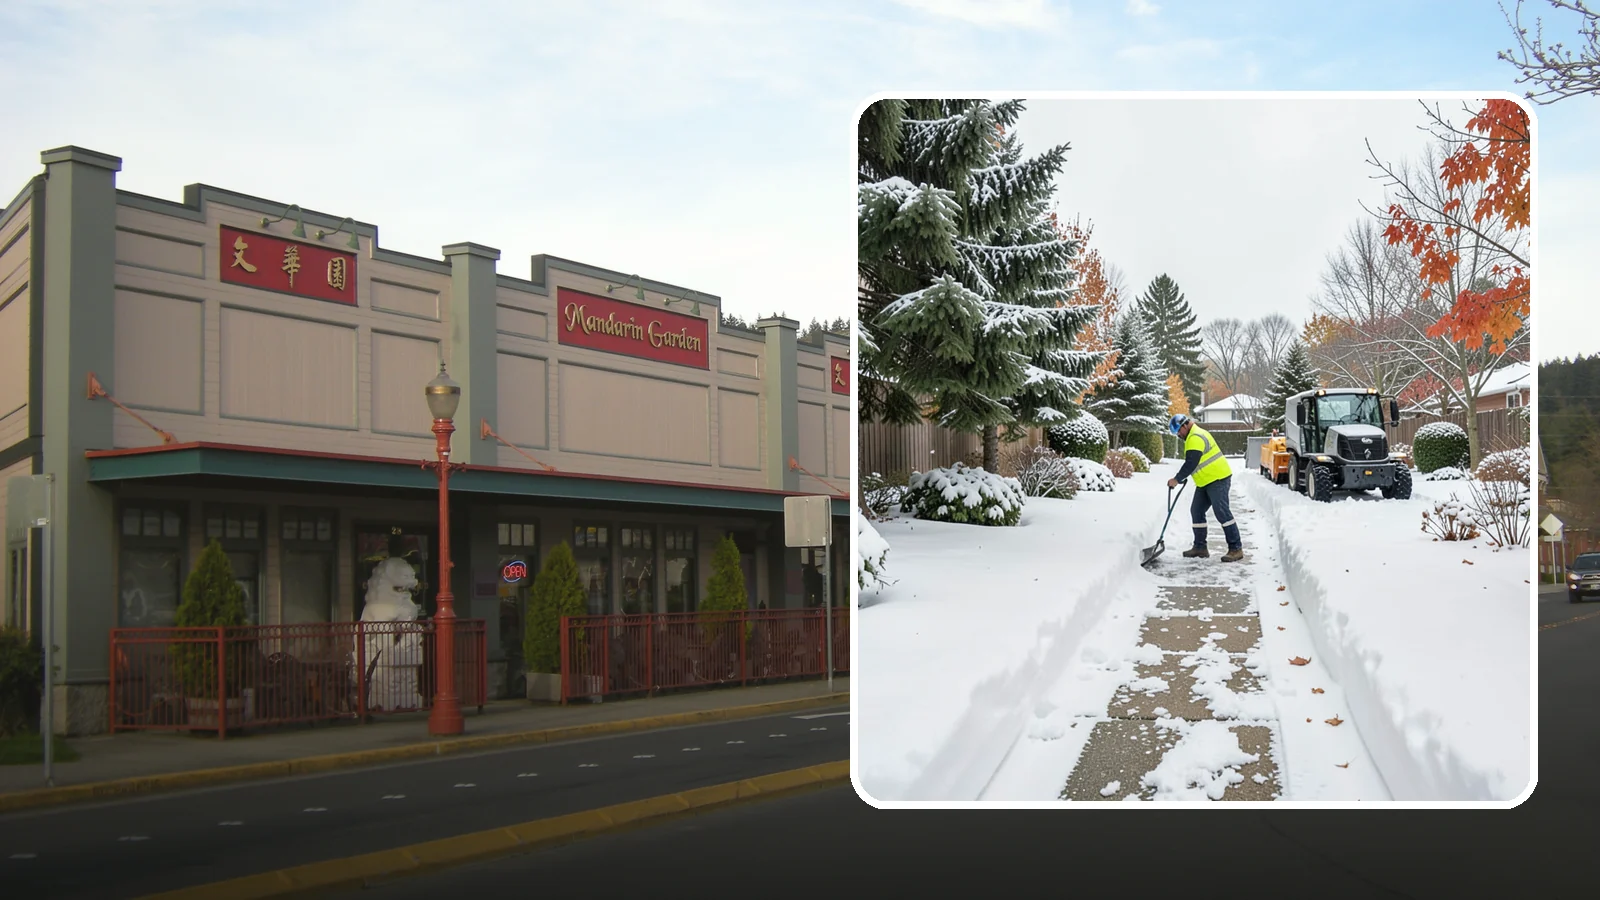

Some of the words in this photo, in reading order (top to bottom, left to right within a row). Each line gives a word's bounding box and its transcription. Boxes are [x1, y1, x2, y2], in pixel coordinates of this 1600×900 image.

[230, 235, 346, 291] 文華園
[564, 302, 644, 341] Mandarin
[647, 320, 701, 352] Garden
[503, 565, 527, 578] OPEN
